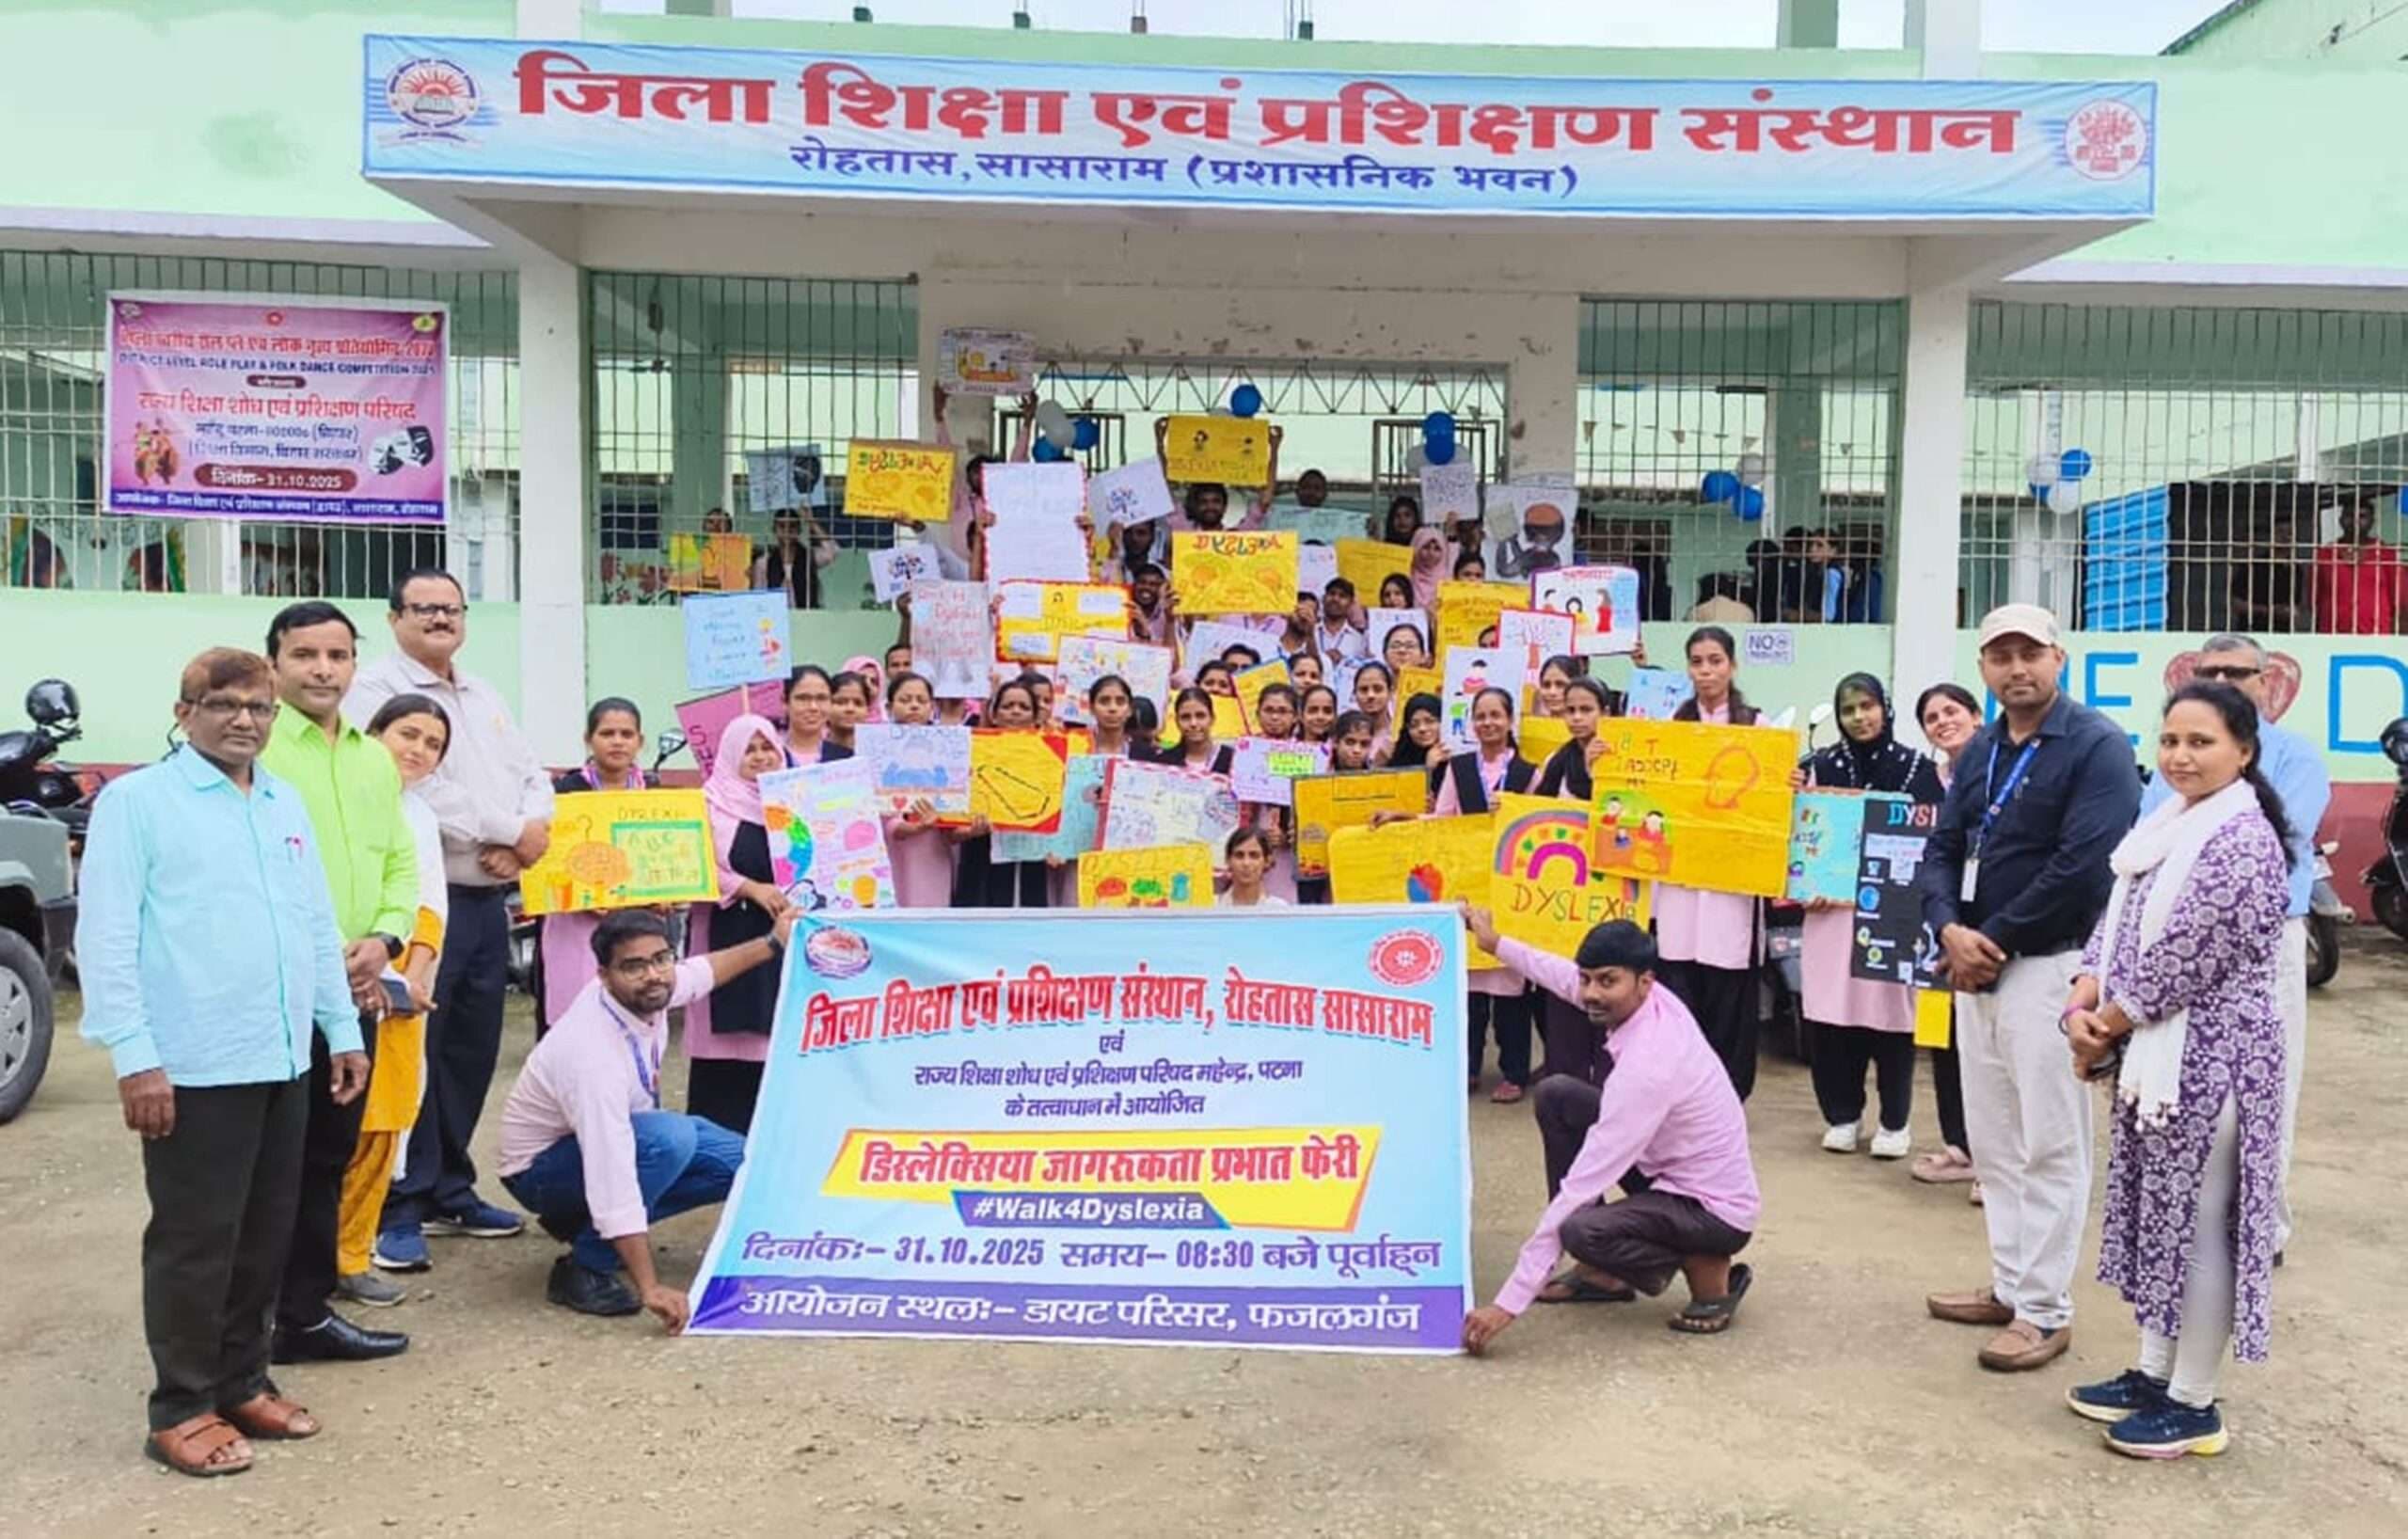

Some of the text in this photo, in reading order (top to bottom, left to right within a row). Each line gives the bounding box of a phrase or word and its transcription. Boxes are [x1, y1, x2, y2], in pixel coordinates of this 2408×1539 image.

[513, 50, 776, 123] जिला
[798, 61, 1069, 139] शिक्षा
[1090, 77, 1236, 149] एवं
[1258, 80, 1660, 154] प्रशिक्षण
[1680, 87, 2022, 154] संस्थान
[1455, 164, 1578, 198] भवन)
[300, 361, 334, 373] DANCE
[267, 473, 342, 488] 31.10.2025
[799, 961, 1434, 1053] जिला शिक्षा एवं प्रशिक्षण संस्थान, रोहतास सासाराम
[1099, 1029, 1124, 1054] एवं
[914, 1065, 957, 1086] राज्य
[958, 1060, 1003, 1086] शिक्षा
[1005, 1061, 1041, 1086] शोध
[1044, 1060, 1070, 1086] एवं
[1071, 1059, 1136, 1088] प्रशिक्षण
[1258, 1059, 1303, 1081] पटना
[1004, 1094, 1023, 1117] के
[1104, 1092, 1123, 1116] में
[1123, 1090, 1205, 1116] आयोजित
[860, 1134, 1361, 1183] डिस्लेक्सिया जागरूकता प्रभात फेरी
[974, 1197, 1205, 1226] #Walk4Dyslexia
[895, 1236, 1045, 1266] 31.10.2025
[1176, 1239, 1255, 1269] 08:30
[1262, 1235, 1320, 1269] बजे
[738, 1283, 892, 1318] आयोजन
[1023, 1296, 1111, 1325] डायट
[1117, 1293, 1238, 1332] परिसर,
[1247, 1293, 1422, 1330] फजलगंज
